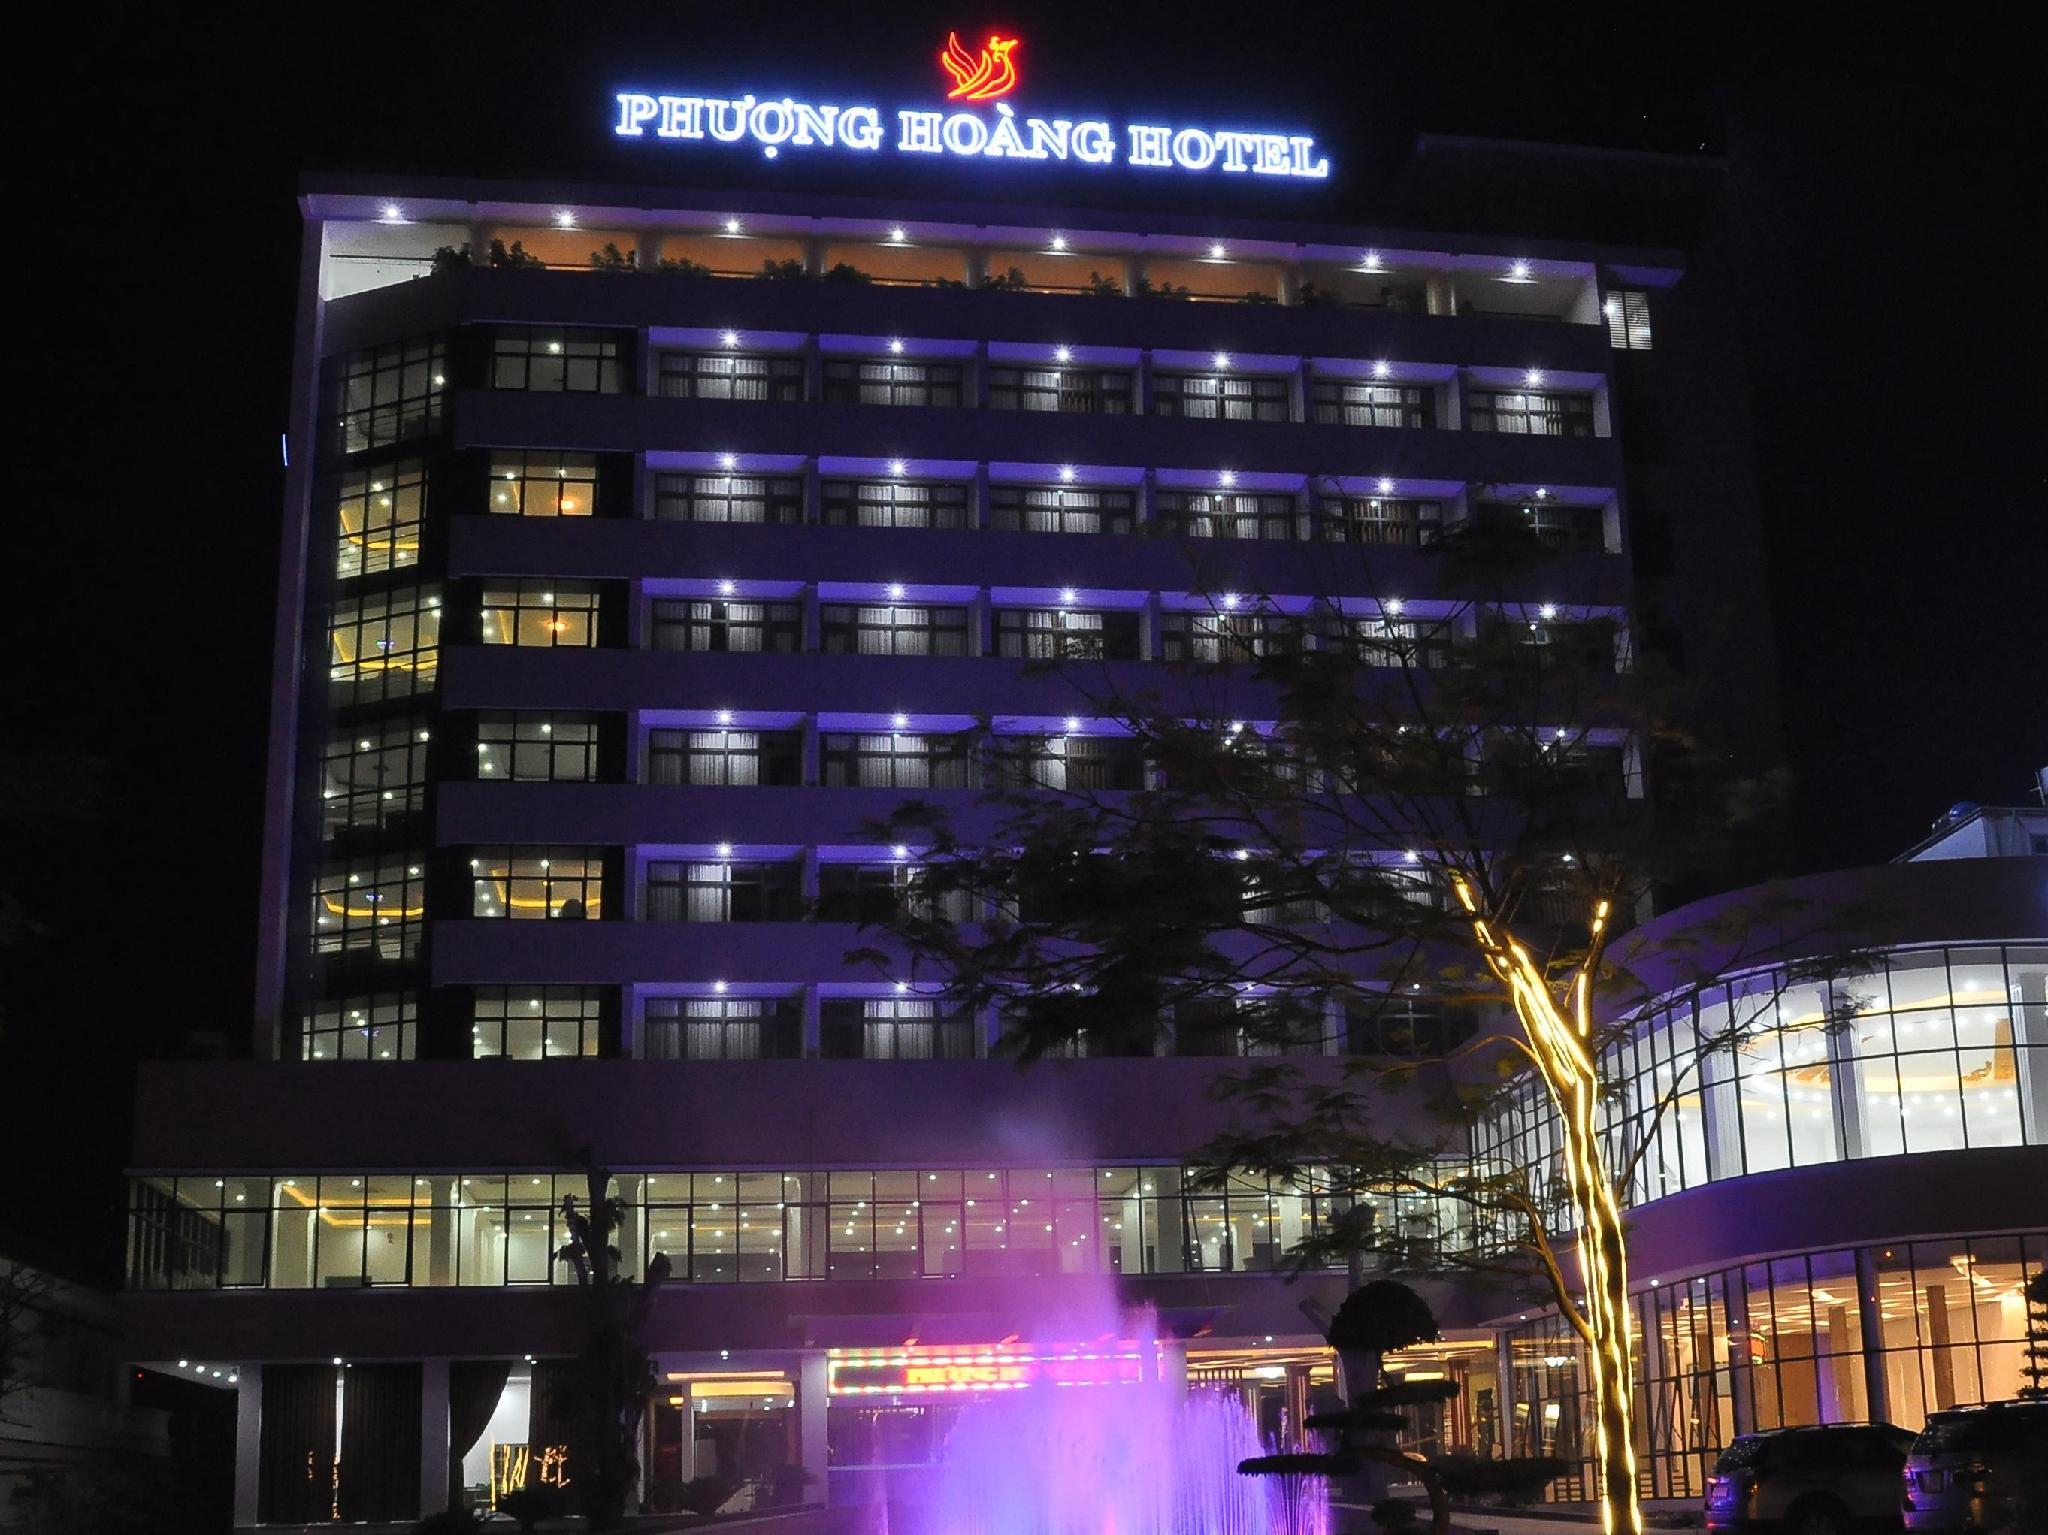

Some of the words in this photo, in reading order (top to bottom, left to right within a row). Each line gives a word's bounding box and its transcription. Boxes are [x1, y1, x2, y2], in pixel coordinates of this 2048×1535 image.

[615, 93, 884, 159] PHƯỢNG
[897, 102, 1116, 164] HOÀNG
[1127, 124, 1329, 178] HOTEL
